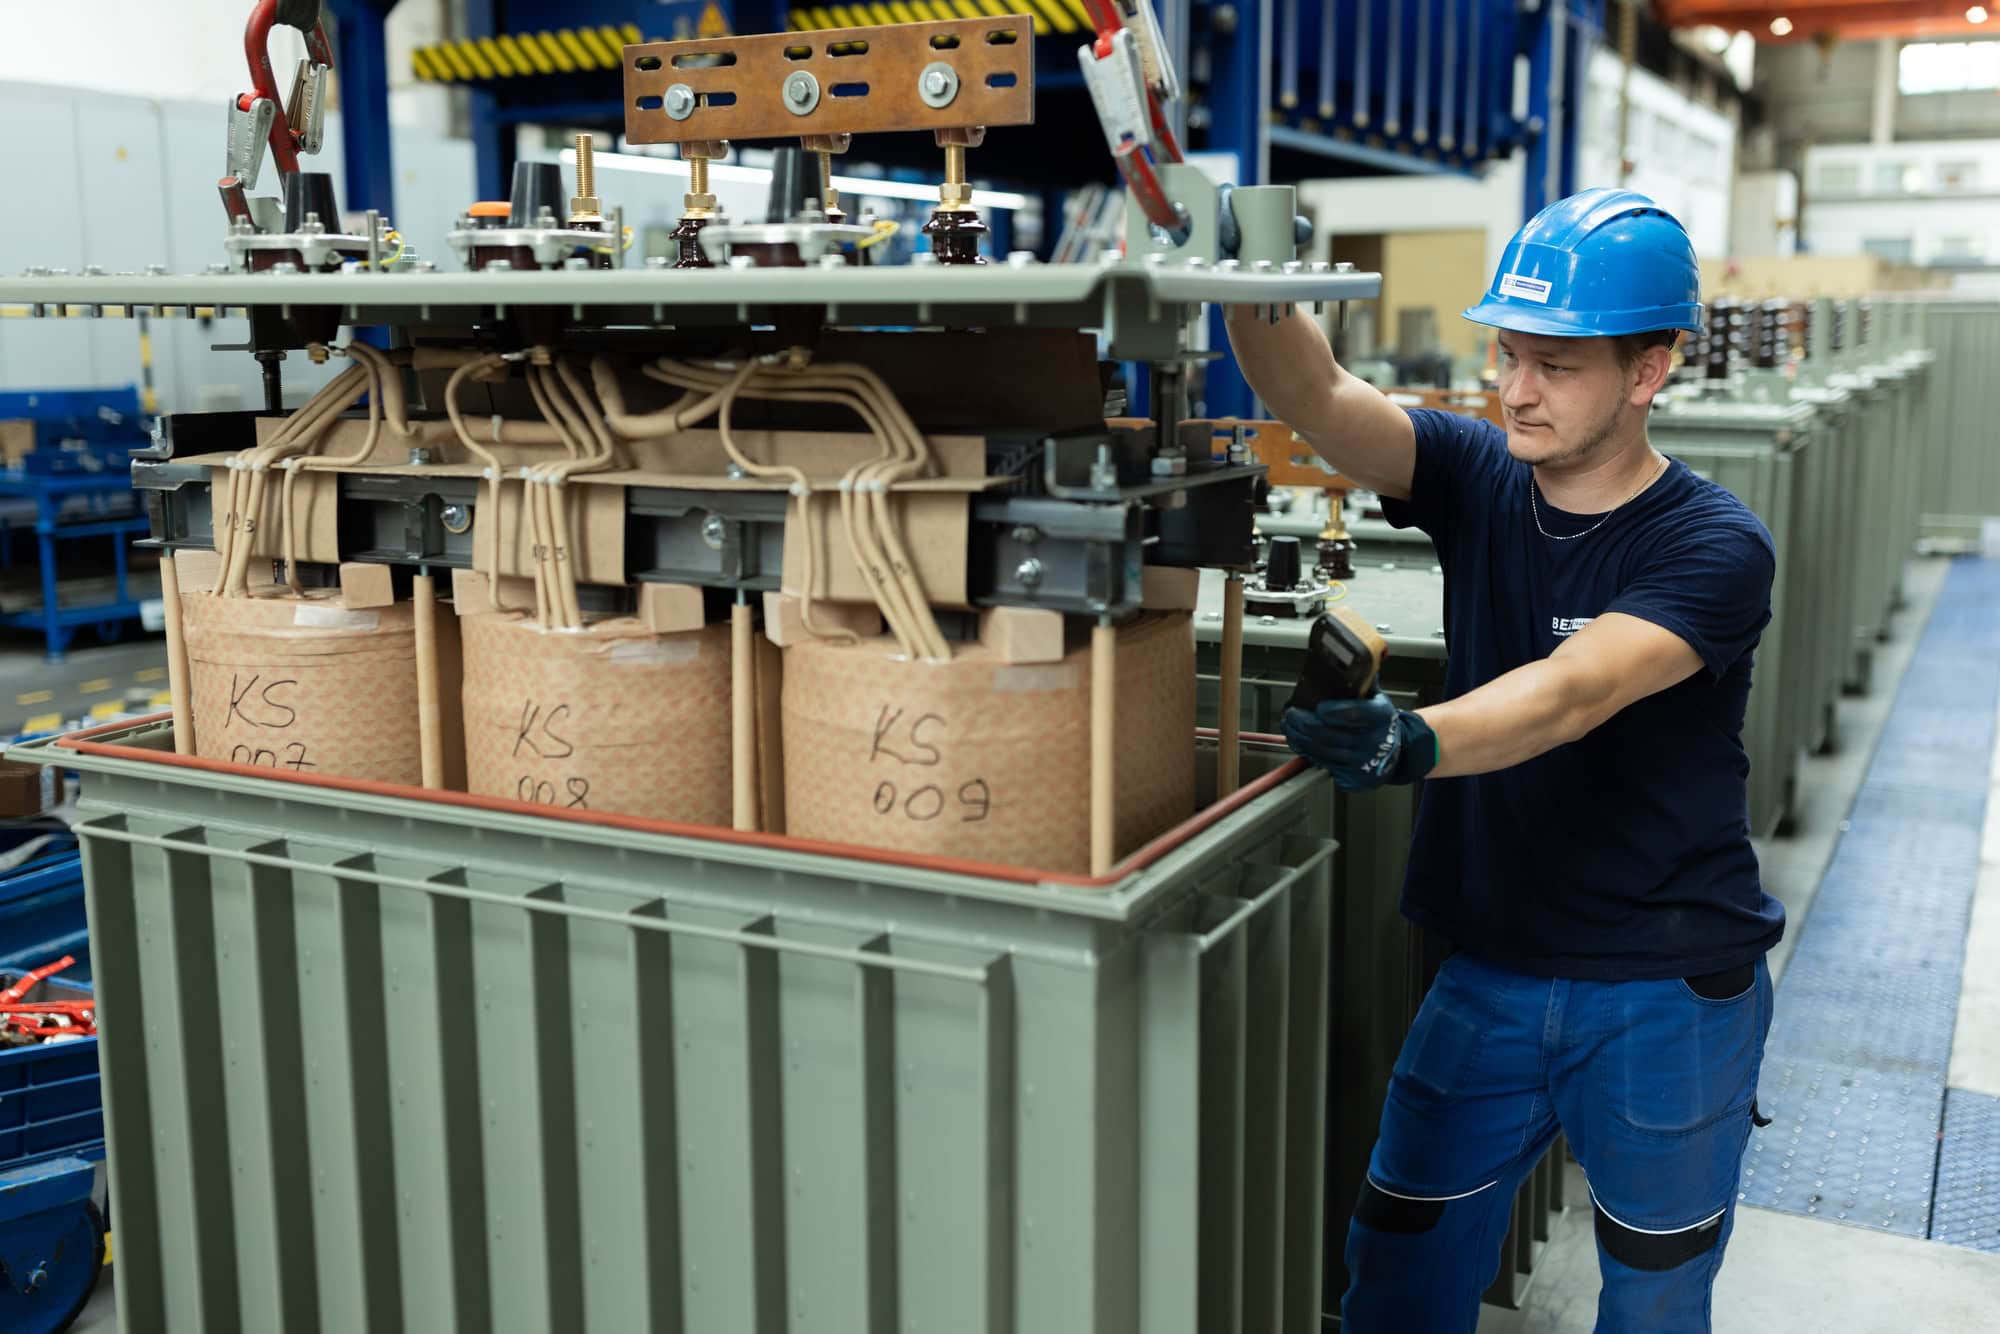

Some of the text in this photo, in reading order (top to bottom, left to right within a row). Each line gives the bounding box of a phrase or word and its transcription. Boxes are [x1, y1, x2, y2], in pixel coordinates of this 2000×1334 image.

[246, 519, 255, 533] 3
[224, 673, 298, 729] KS
[512, 698, 574, 759] KS
[868, 703, 948, 766] KS
[873, 778, 991, 822] 009
